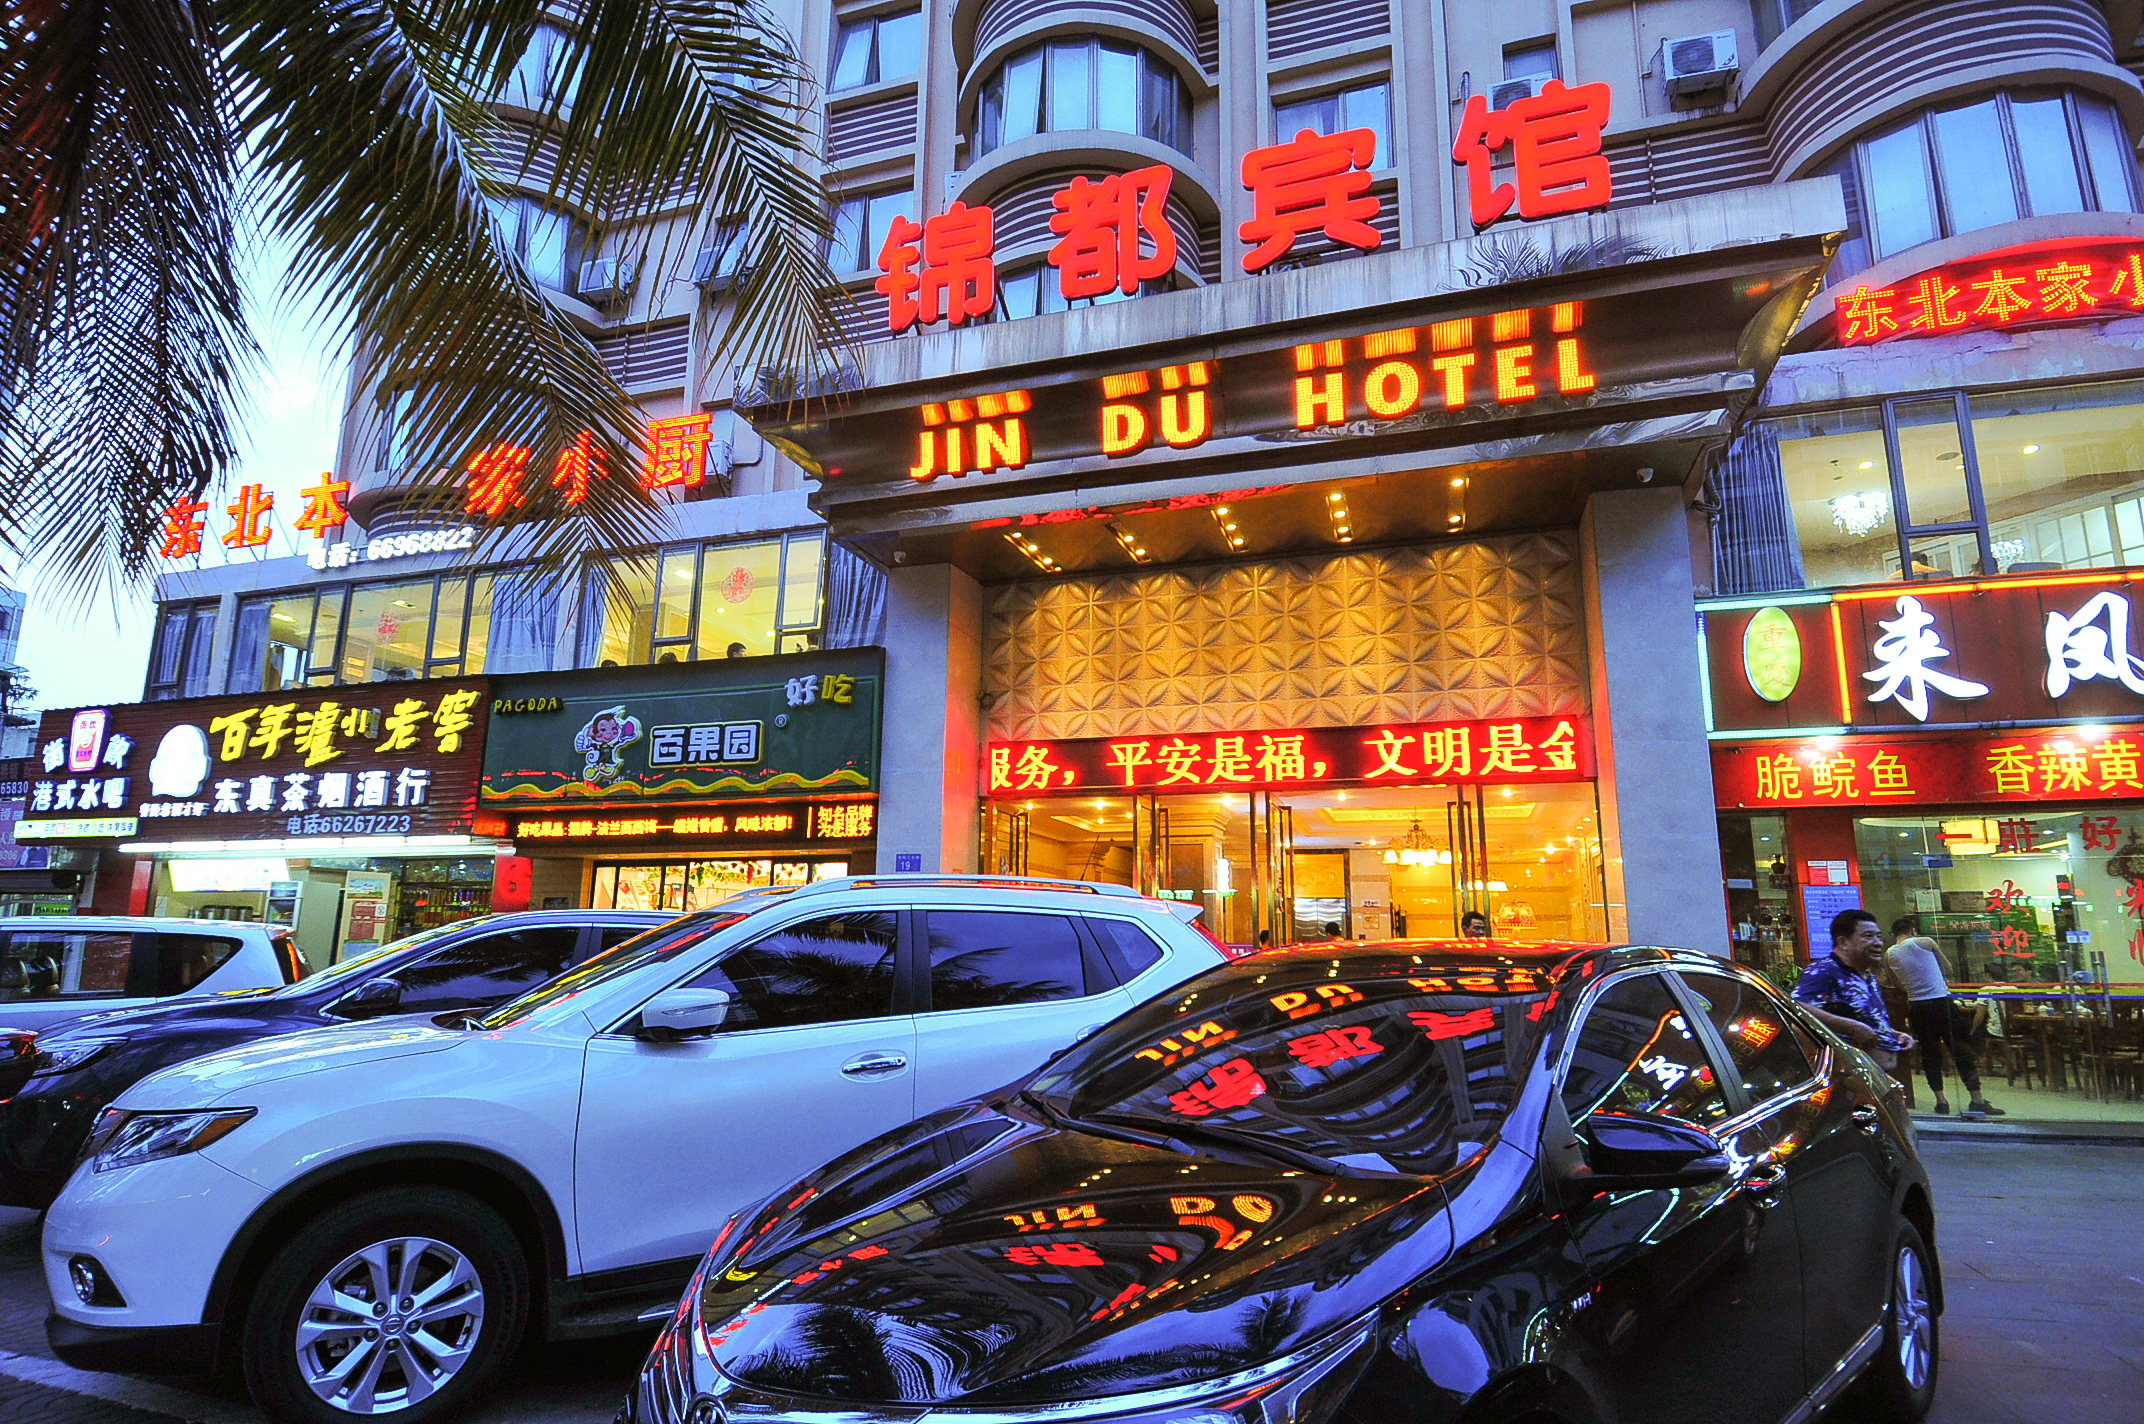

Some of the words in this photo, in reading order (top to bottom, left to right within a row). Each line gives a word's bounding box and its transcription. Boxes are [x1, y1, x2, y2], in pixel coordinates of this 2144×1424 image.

[874, 78, 1613, 332] 锦都宾馆
[909, 418, 1029, 481] JIN
[1102, 390, 1212, 456] DU
[1294, 336, 1596, 429] HOTEL
[494, 697, 557, 713] PAGODA
[785, 674, 855, 707] 好吃
[652, 724, 758, 764] 百果园
[1756, 749, 1916, 801] 脆鲩鱼
[1986, 739, 2144, 793] 香辣黄
[30, 778, 126, 812] 港式水吧
[213, 768, 430, 814] 东真茶烟酒行
[286, 815, 412, 835] 电话66267223
[818, 805, 874, 823] 知名品牌
[1985, 879, 2036, 958] 欢迎
